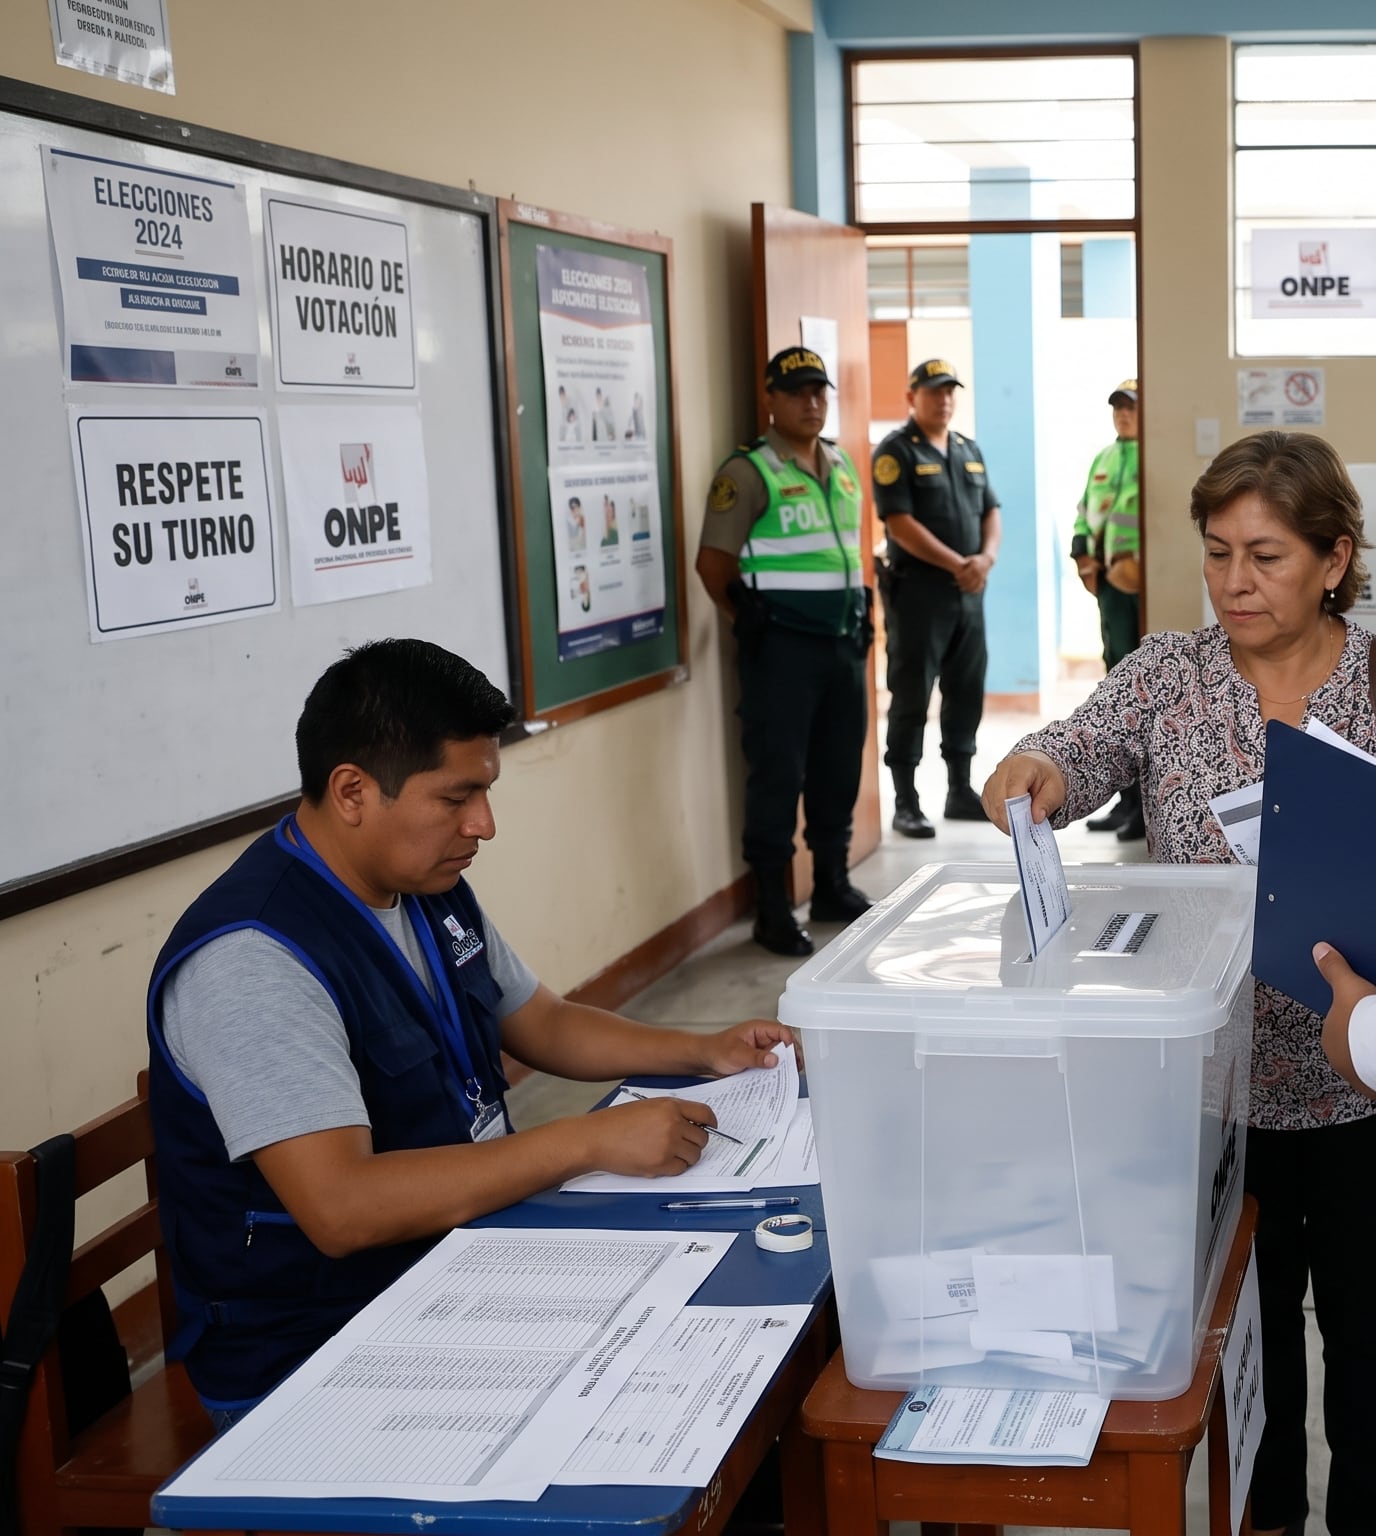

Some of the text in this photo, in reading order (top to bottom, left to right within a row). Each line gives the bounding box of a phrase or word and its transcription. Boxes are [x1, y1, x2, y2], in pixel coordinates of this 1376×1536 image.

[94, 177, 214, 222] ELECCIONES
[134, 219, 183, 250] 2024
[280, 244, 405, 295] HORARIO DE
[1281, 276, 1350, 296] ONPE
[295, 296, 398, 339] VOTACIÓN
[116, 460, 244, 507] RESPETE
[112, 514, 256, 567] SU TURNO
[324, 502, 401, 548] ONPE
